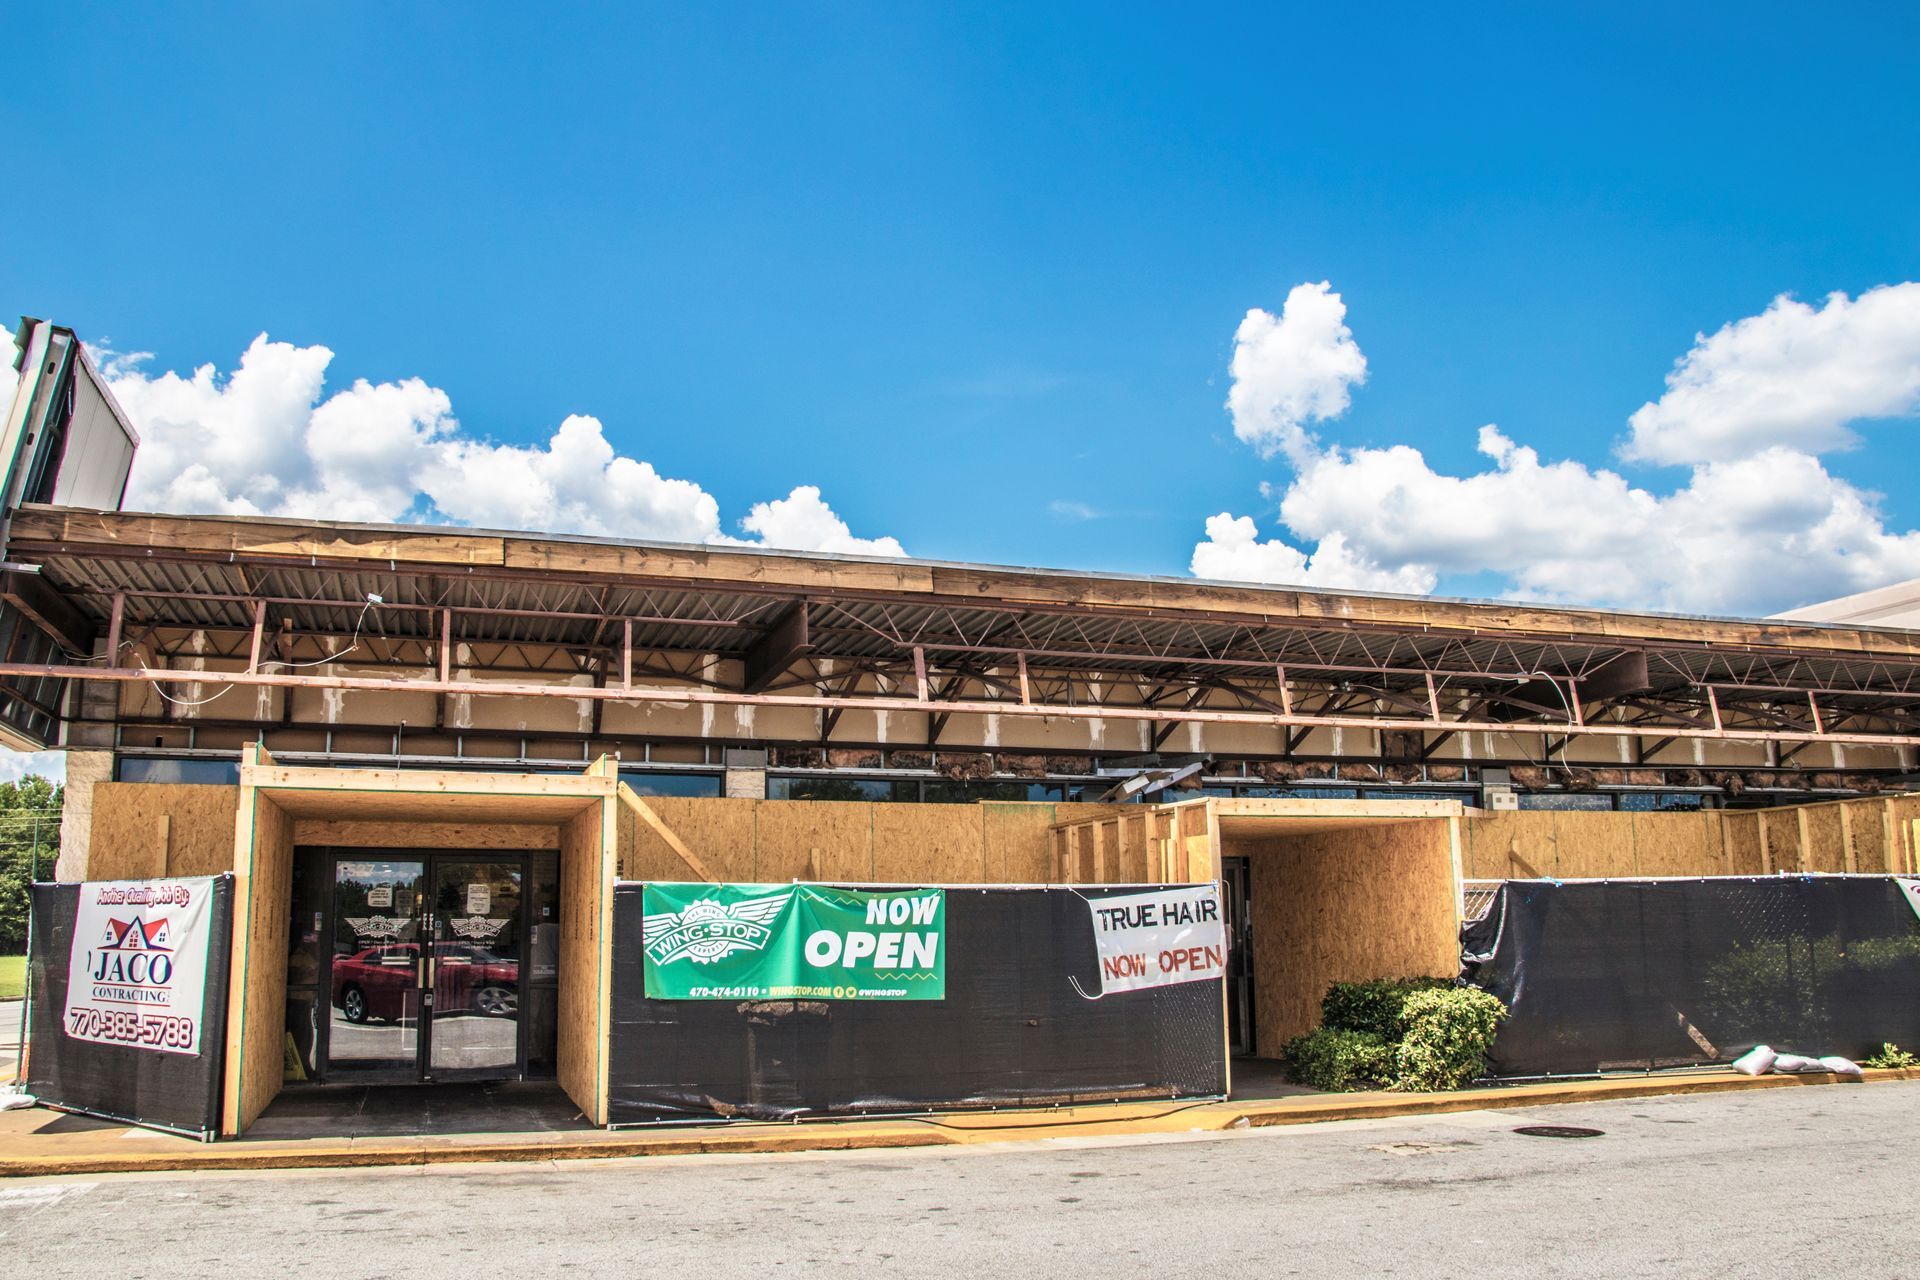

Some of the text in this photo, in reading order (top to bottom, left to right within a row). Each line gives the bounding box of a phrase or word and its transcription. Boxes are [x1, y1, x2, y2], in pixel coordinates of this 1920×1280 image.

[126, 887, 155, 908] Quality
[156, 886, 173, 904] Job
[174, 885, 190, 908] By:
[865, 896, 940, 926] NOW
[1097, 899, 1218, 931] TRUE HAIR
[804, 930, 939, 969] OPEN
[1103, 944, 1222, 980] NOW OPEN
[94, 952, 172, 985] JACO
[92, 986, 166, 1003] CONTRACTING
[690, 986, 908, 997] 470-474-0110 WINGSTOP.COM @WINGSTOP
[70, 1007, 193, 1049] 770-385-5788
